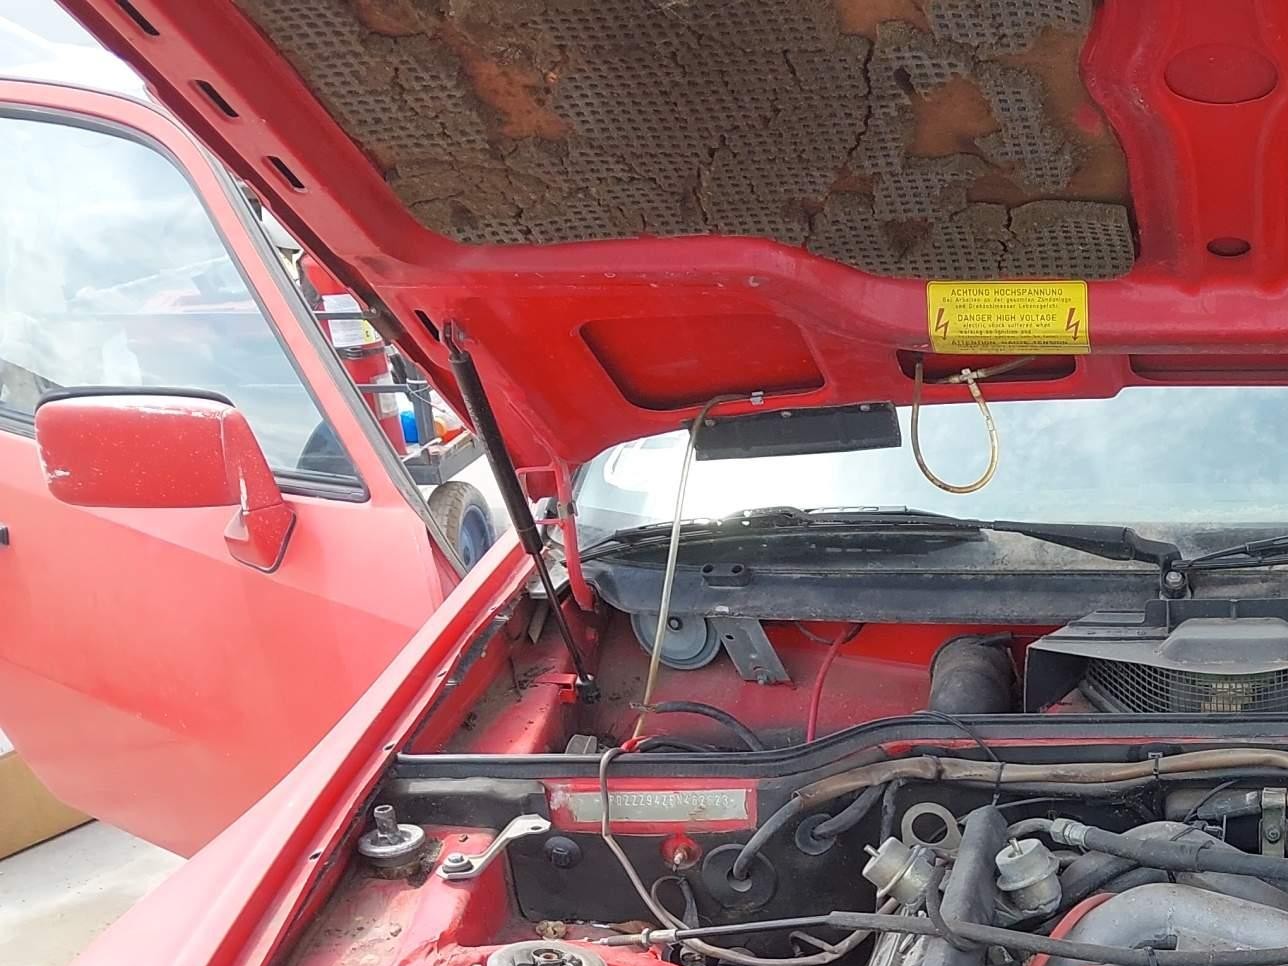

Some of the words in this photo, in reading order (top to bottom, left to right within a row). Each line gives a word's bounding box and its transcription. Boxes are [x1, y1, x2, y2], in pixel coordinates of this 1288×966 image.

[951, 288, 990, 297] ACHTUNG
[957, 314, 993, 322] DANGER
[996, 314, 1016, 322] HIGH
[1019, 313, 1057, 322] VOLTAGE
